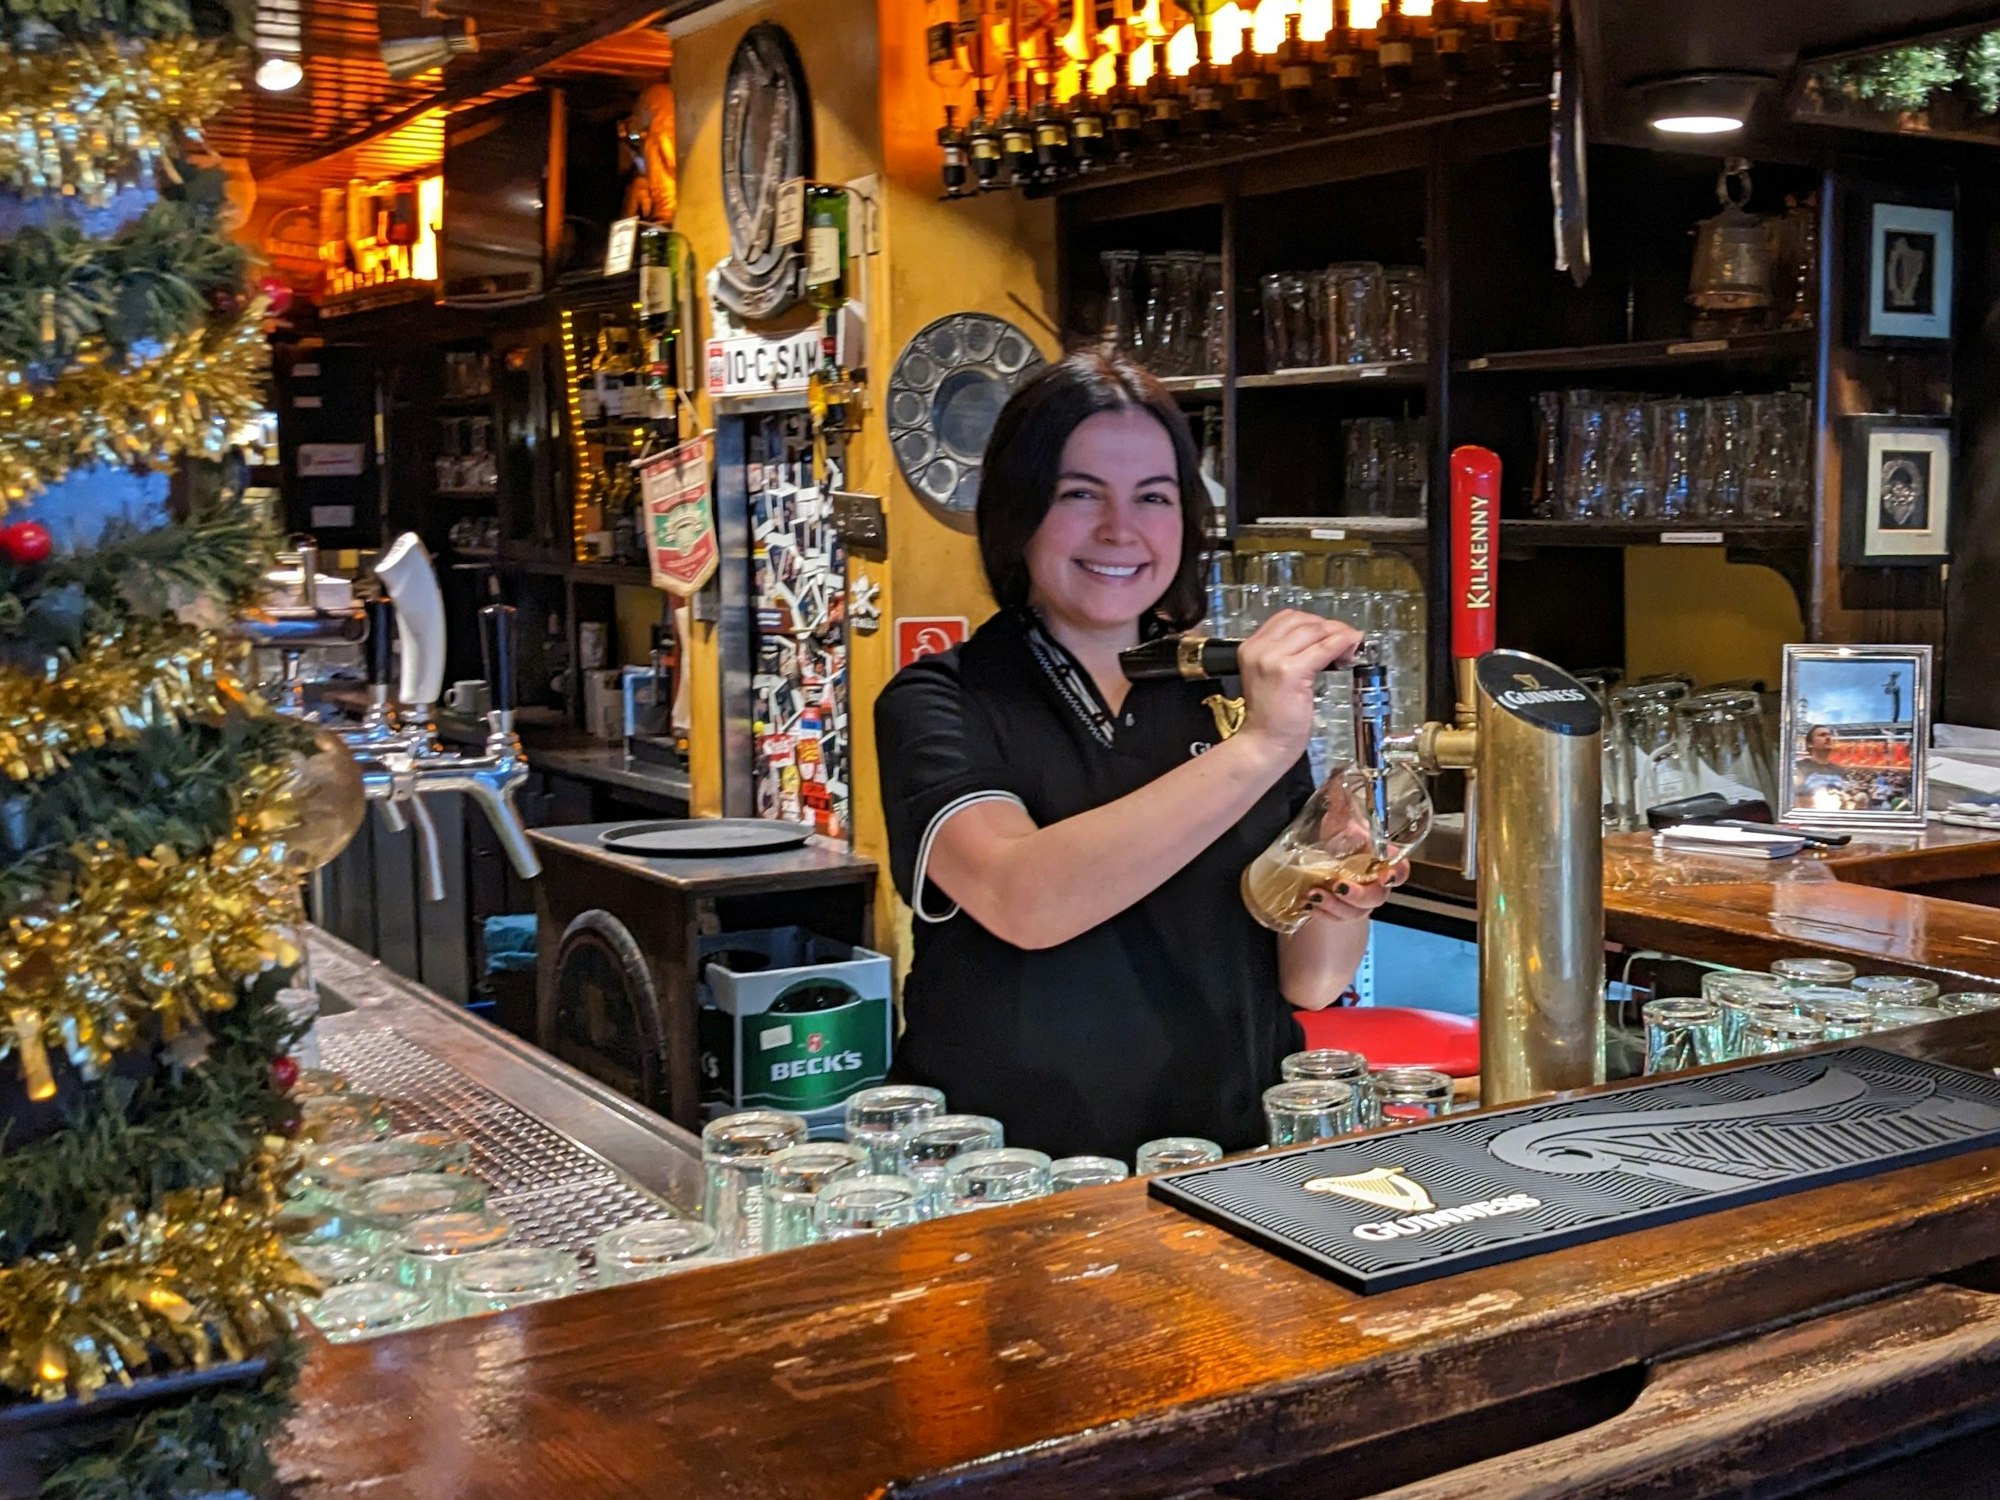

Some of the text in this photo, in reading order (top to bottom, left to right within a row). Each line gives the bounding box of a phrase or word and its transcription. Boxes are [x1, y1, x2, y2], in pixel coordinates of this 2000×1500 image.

[1466, 495, 1492, 610] KILKENNY
[1503, 688, 1587, 705] GUINNESS
[770, 1050, 863, 1082] BECK'S
[745, 1185, 763, 1245] WESTONS
[1352, 1193, 1542, 1242] GUINNESS
